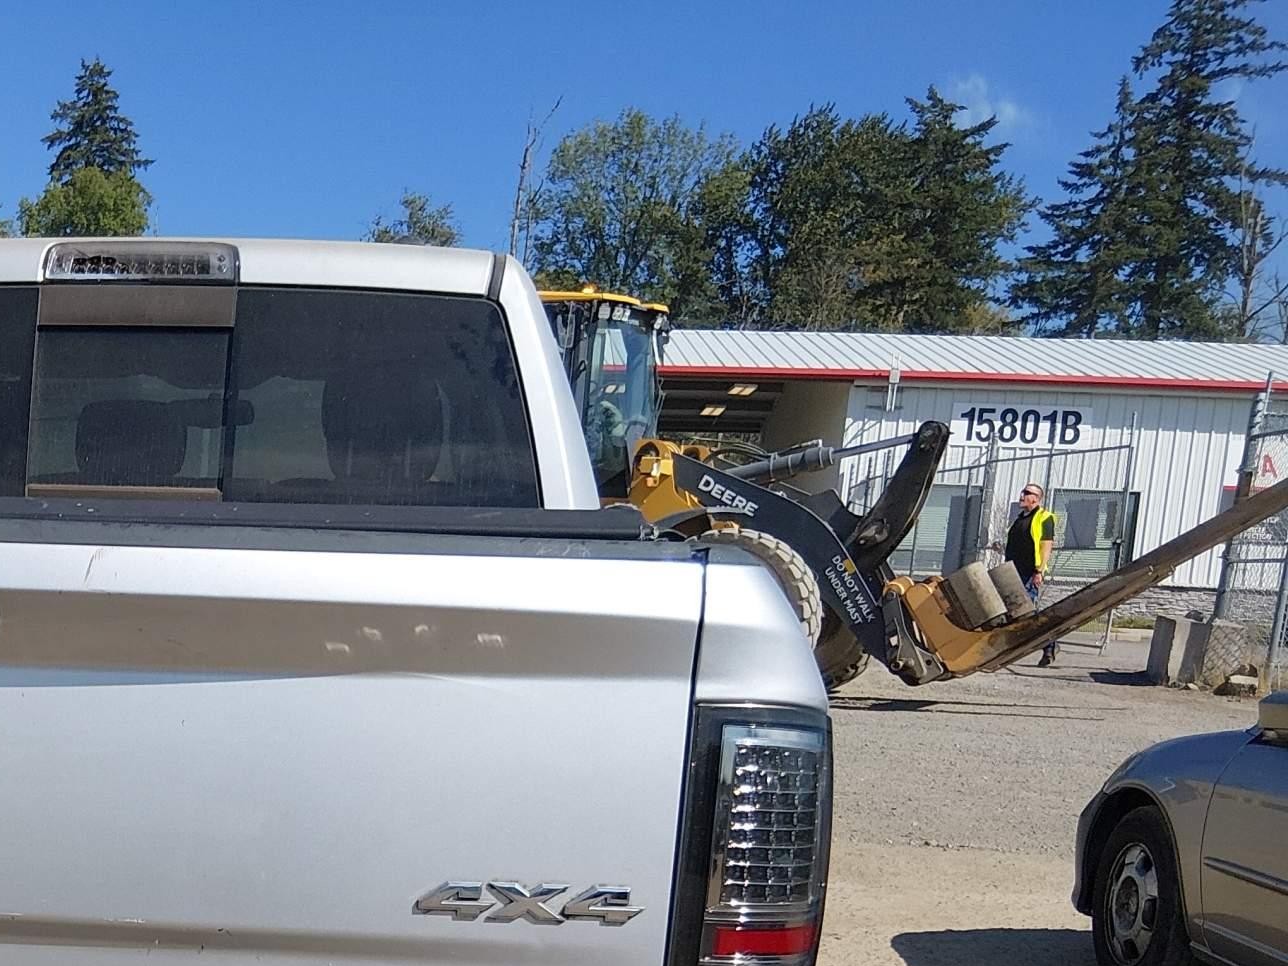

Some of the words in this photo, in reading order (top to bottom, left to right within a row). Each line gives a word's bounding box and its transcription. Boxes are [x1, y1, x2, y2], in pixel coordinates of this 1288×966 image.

[960, 406, 1082, 445] 15801B
[697, 474, 759, 517] DEERE
[825, 567, 848, 600] UNDER
[843, 599, 863, 625] MAST
[832, 554, 845, 572] DO
[842, 571, 859, 593] NOT
[855, 592, 876, 623] WALK
[412, 880, 646, 927] 4X4
